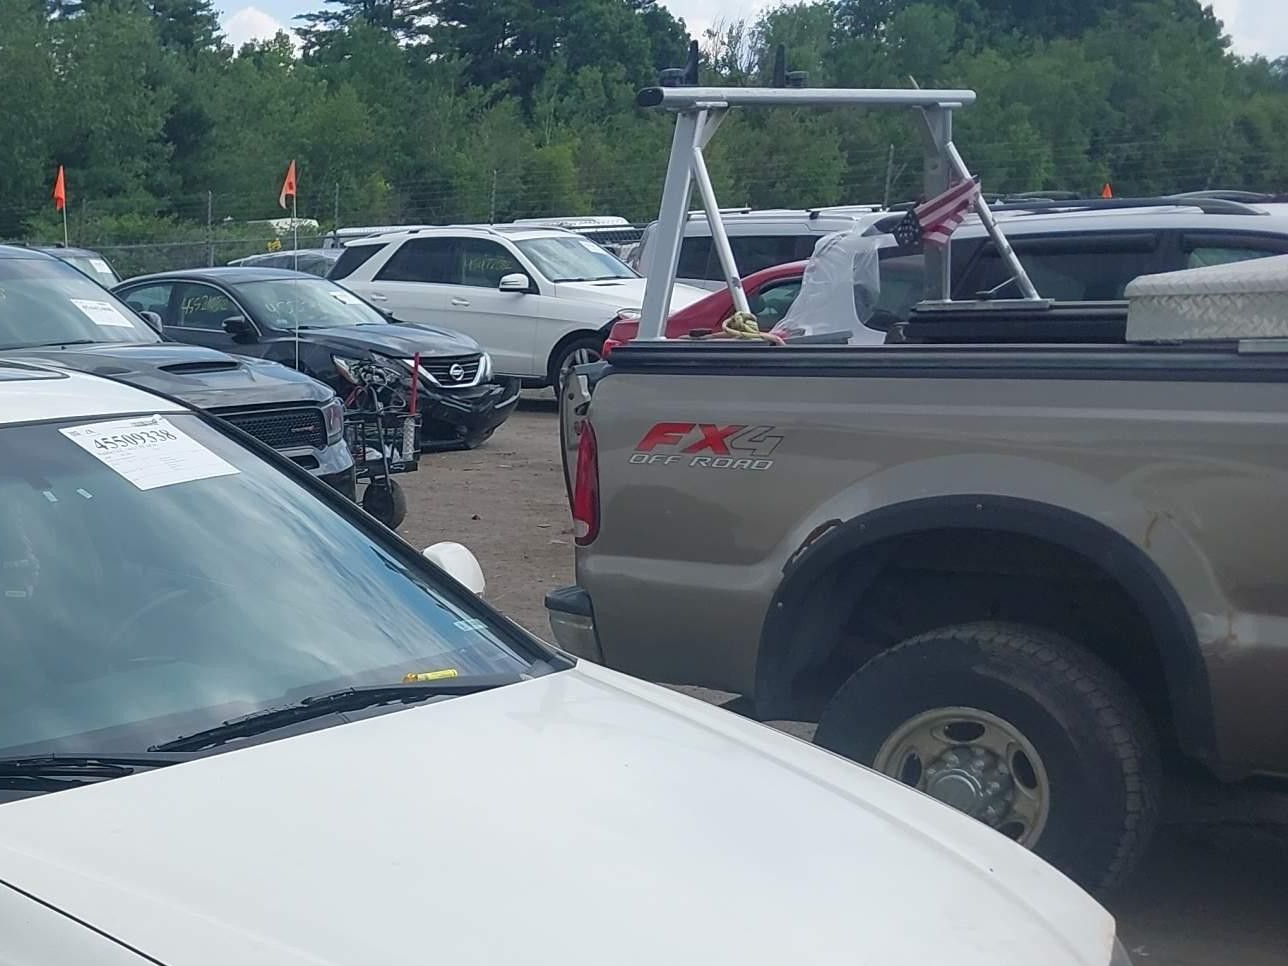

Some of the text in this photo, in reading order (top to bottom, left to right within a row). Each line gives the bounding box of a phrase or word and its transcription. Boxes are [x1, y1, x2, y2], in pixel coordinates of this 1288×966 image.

[93, 429, 178, 451] 45509338
[634, 422, 784, 456] FX4
[628, 453, 775, 471] OFF ROAD
